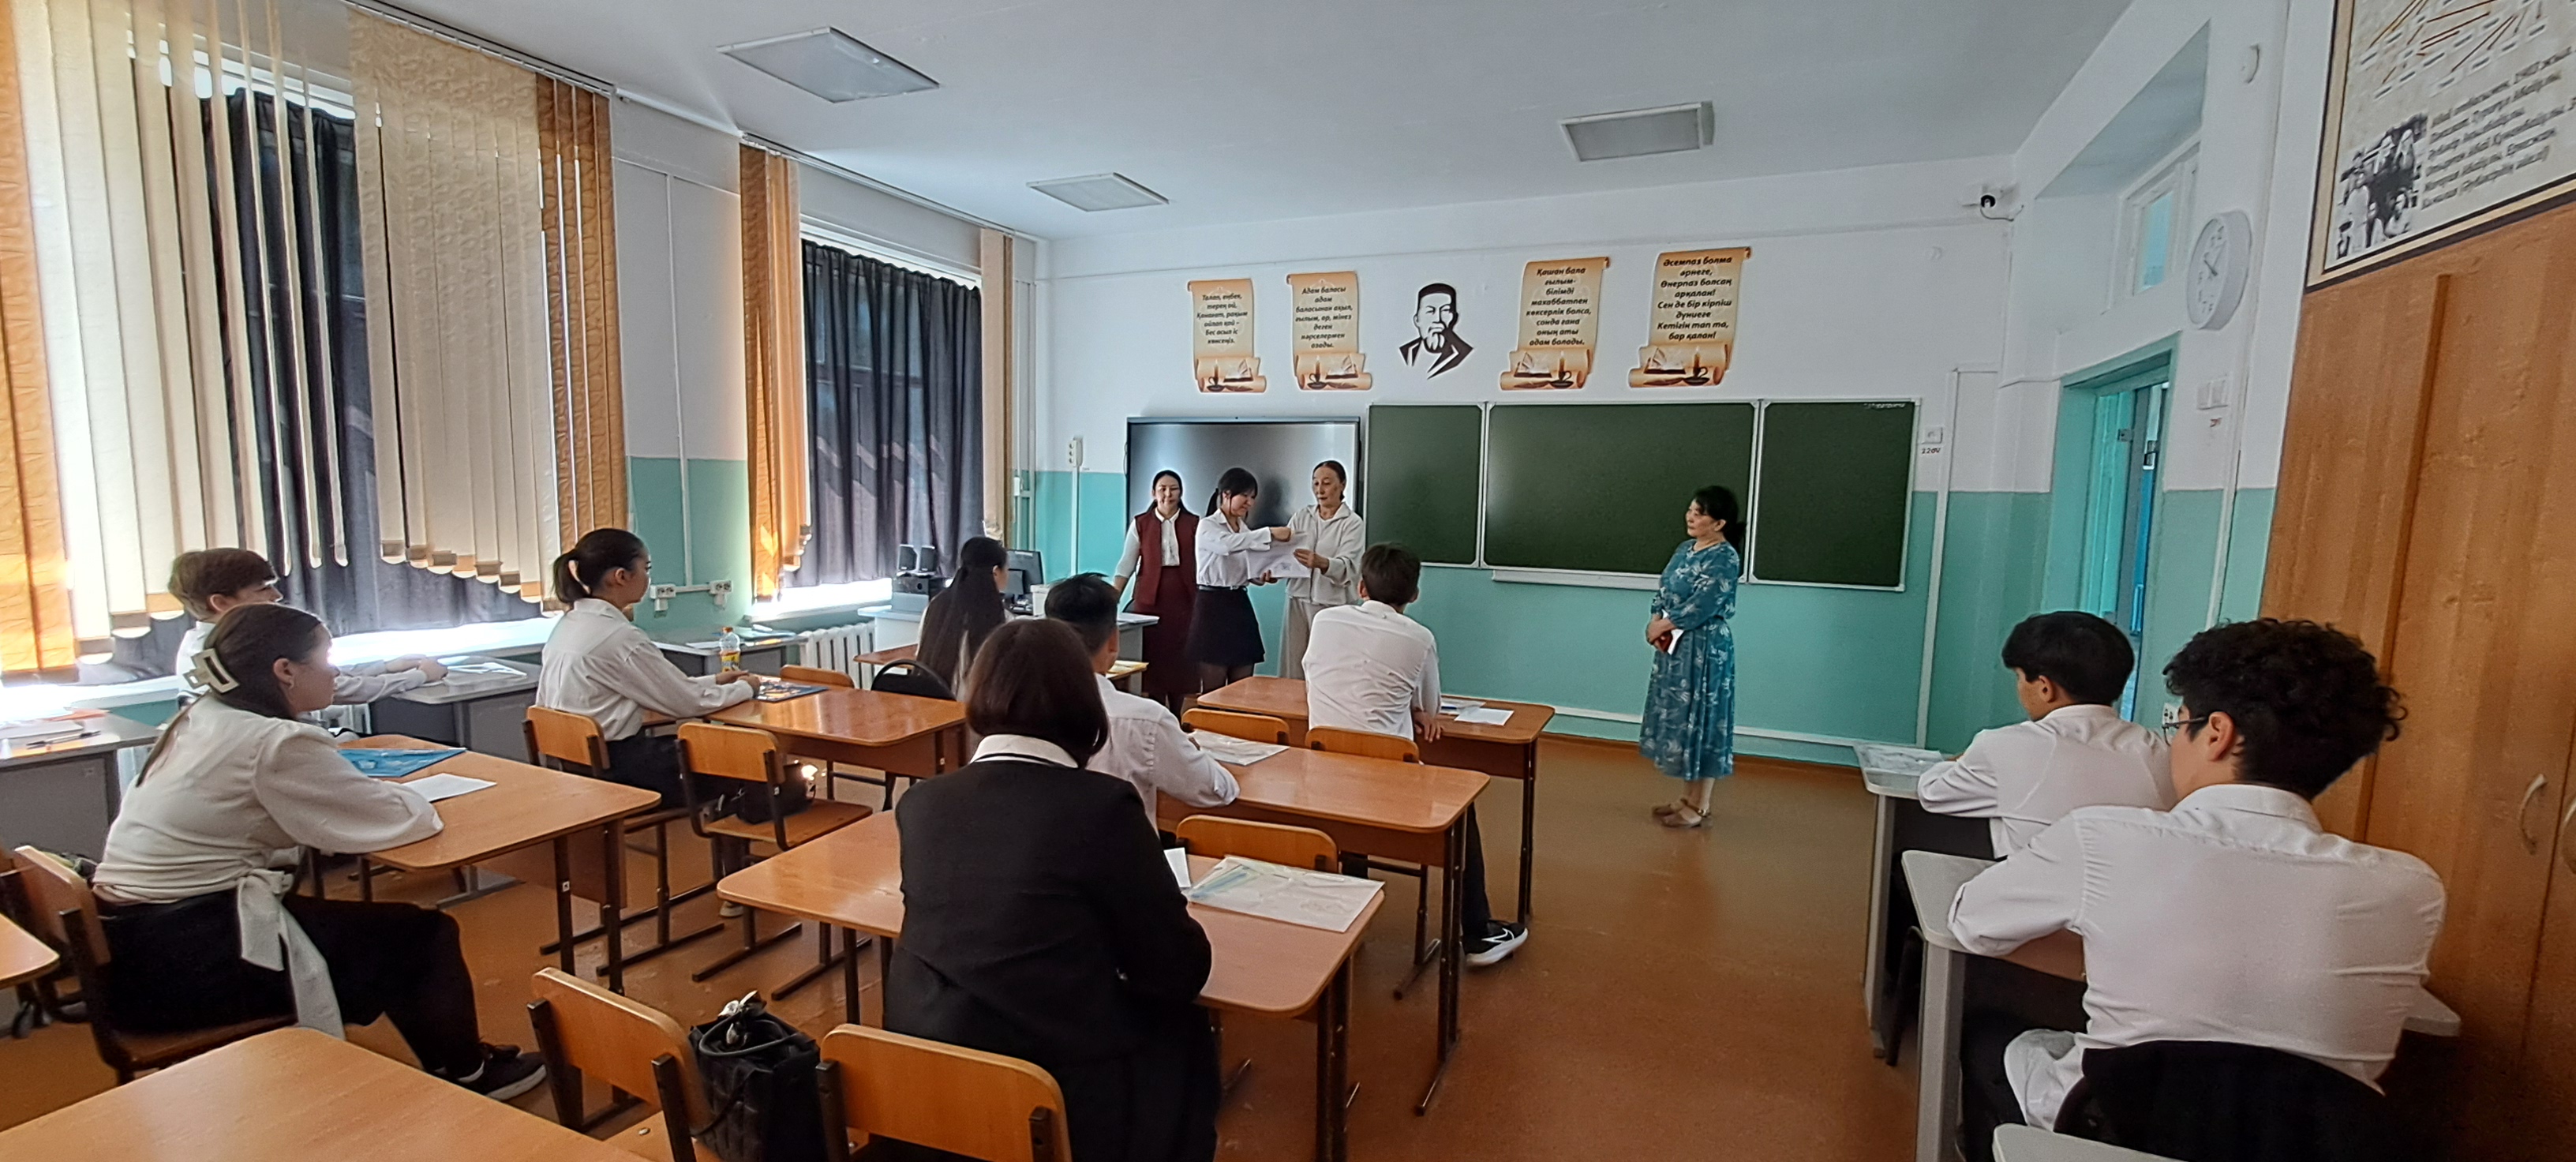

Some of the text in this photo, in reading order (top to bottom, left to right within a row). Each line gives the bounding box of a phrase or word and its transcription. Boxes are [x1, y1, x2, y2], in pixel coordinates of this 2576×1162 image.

[1703, 256, 1732, 265] болма
[1661, 278, 1732, 289] Өнерпаз болсаң
[1675, 289, 1716, 298] арқалан!
[1687, 300, 1701, 309] бір
[1702, 298, 1732, 309] кірпіш
[1676, 311, 1711, 320] дүниеге
[1657, 321, 1690, 330] Кетігін
[1668, 332, 1685, 341] бар
